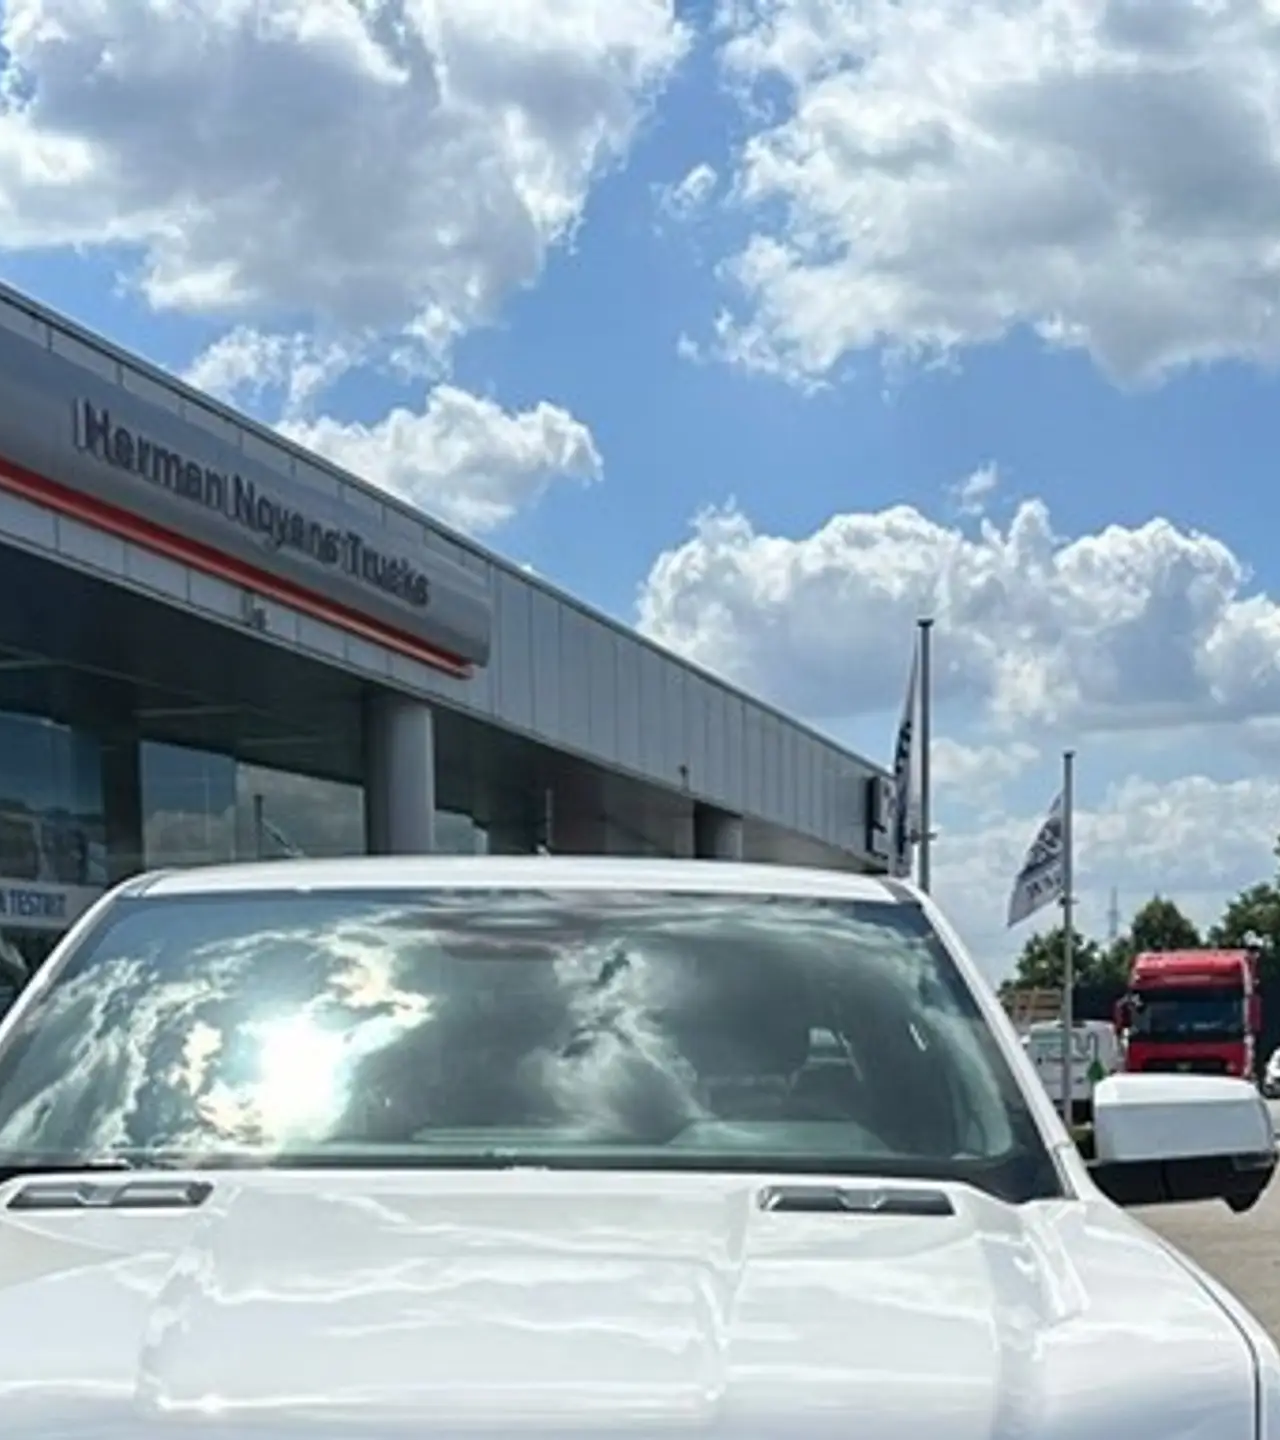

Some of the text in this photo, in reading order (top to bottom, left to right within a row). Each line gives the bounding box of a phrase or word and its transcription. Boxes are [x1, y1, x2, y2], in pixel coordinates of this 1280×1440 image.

[74, 397, 430, 608] Herman Noyens Trucks
